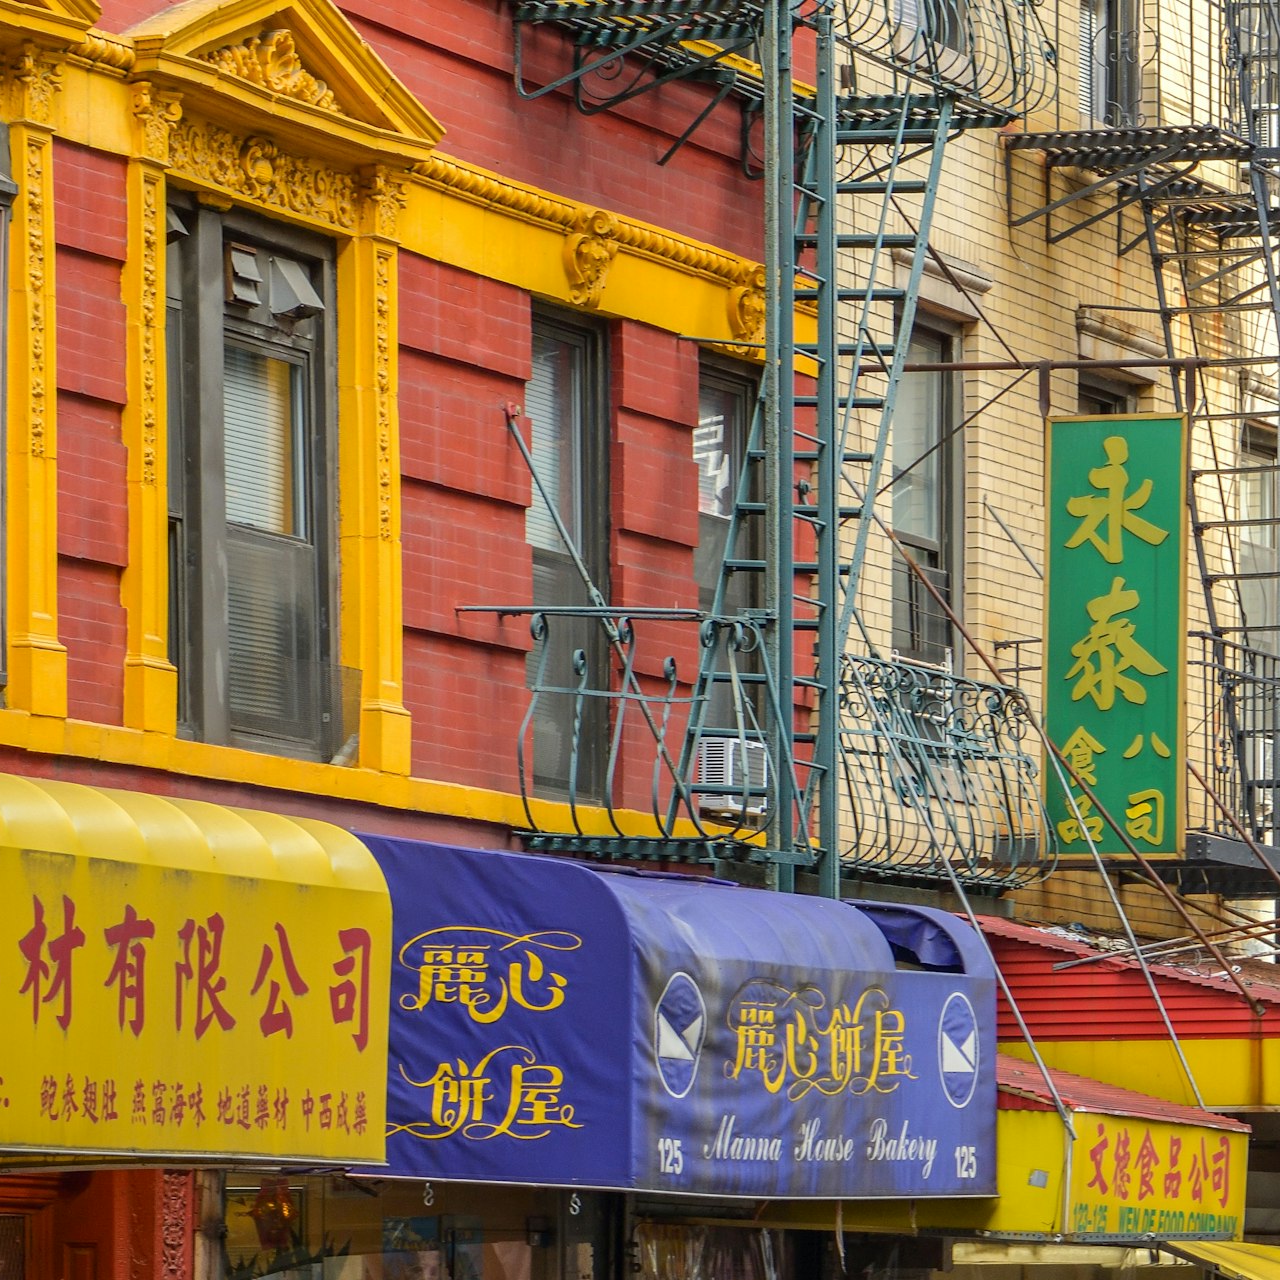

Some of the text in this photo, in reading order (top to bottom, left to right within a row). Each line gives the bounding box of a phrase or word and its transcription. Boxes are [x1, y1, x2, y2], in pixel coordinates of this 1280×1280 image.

[1064, 436, 1169, 712] 永泰
[1057, 725, 1107, 845] 食品
[400, 926, 584, 1025] 麗心
[723, 976, 920, 1102] 麗心餅屋
[658, 1115, 978, 1181] 125 Manna House Bakery 125
